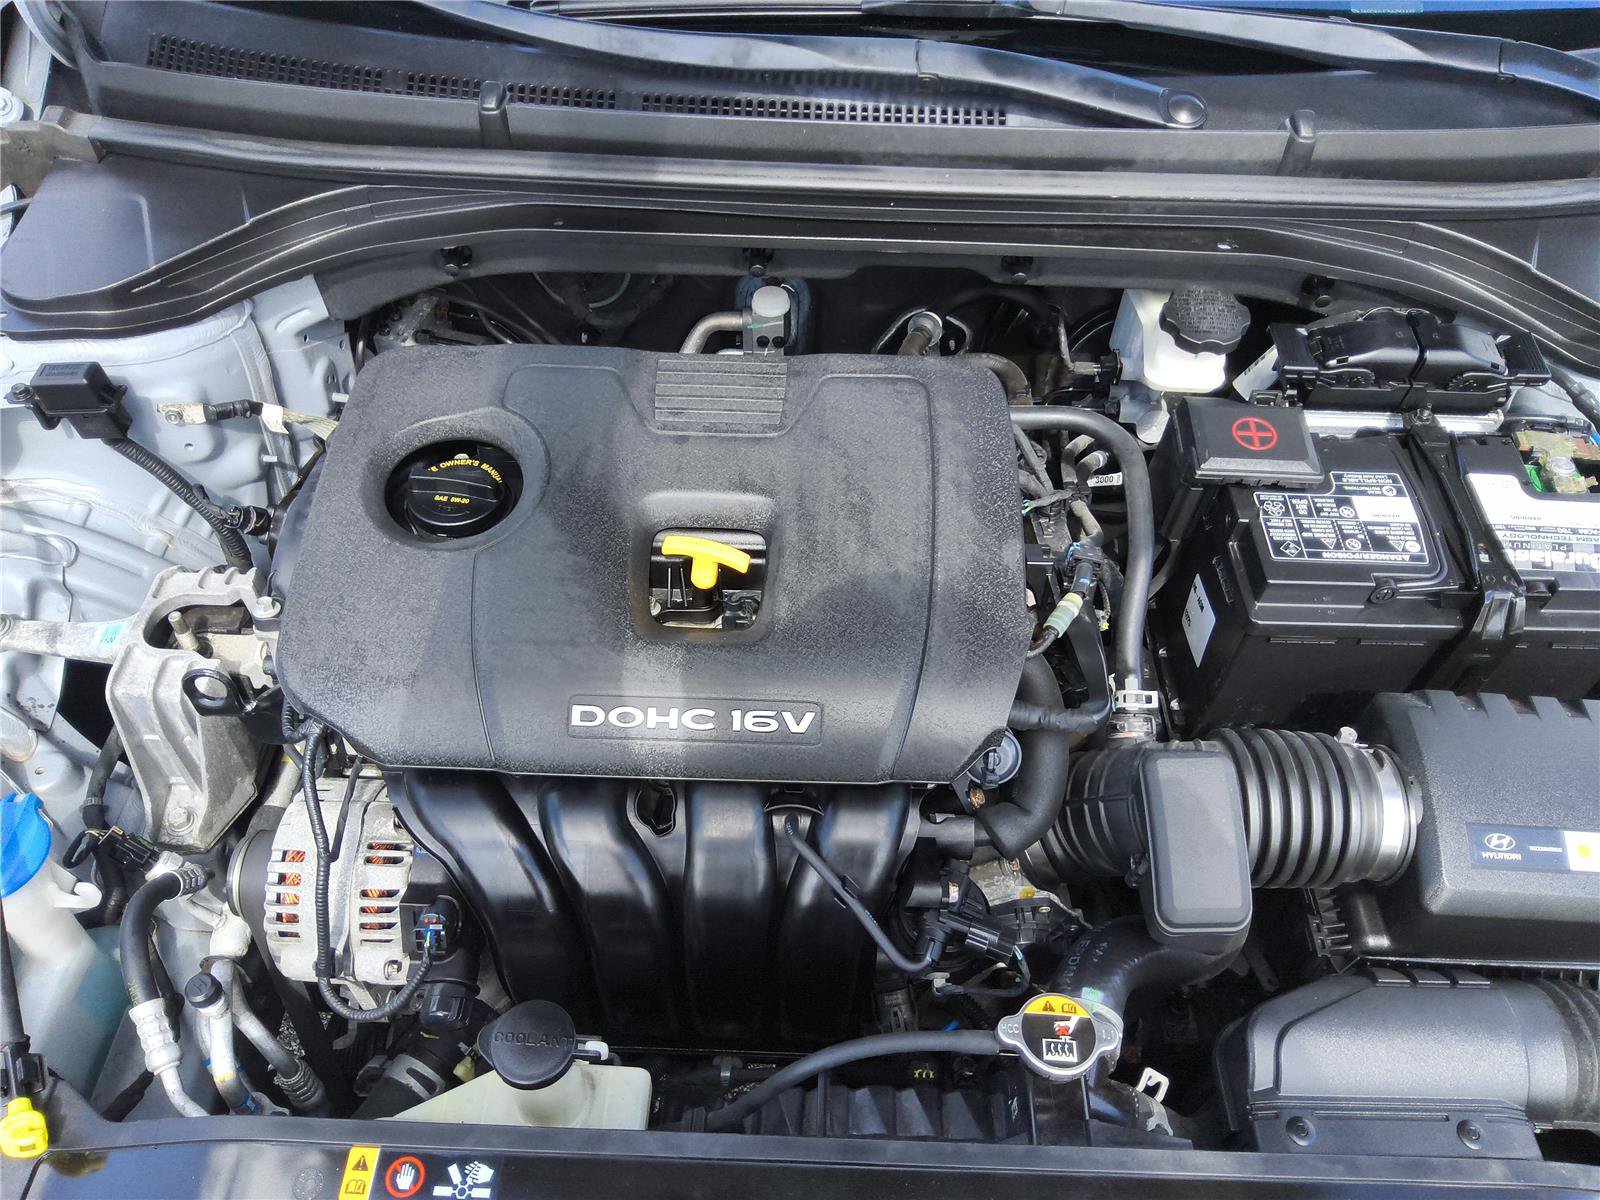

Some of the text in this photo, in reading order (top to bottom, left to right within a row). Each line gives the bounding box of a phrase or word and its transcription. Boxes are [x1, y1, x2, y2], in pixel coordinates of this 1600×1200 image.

[440, 460, 480, 468] OWNER'S
[1095, 476, 1114, 484] 3000
[450, 496, 470, 504] 5W-20
[1502, 533, 1574, 542] TECHNOLOGY
[571, 704, 816, 734] DOHC 16V
[1482, 852, 1521, 861] HYUNDAI
[494, 1032, 574, 1048] COOLANT
